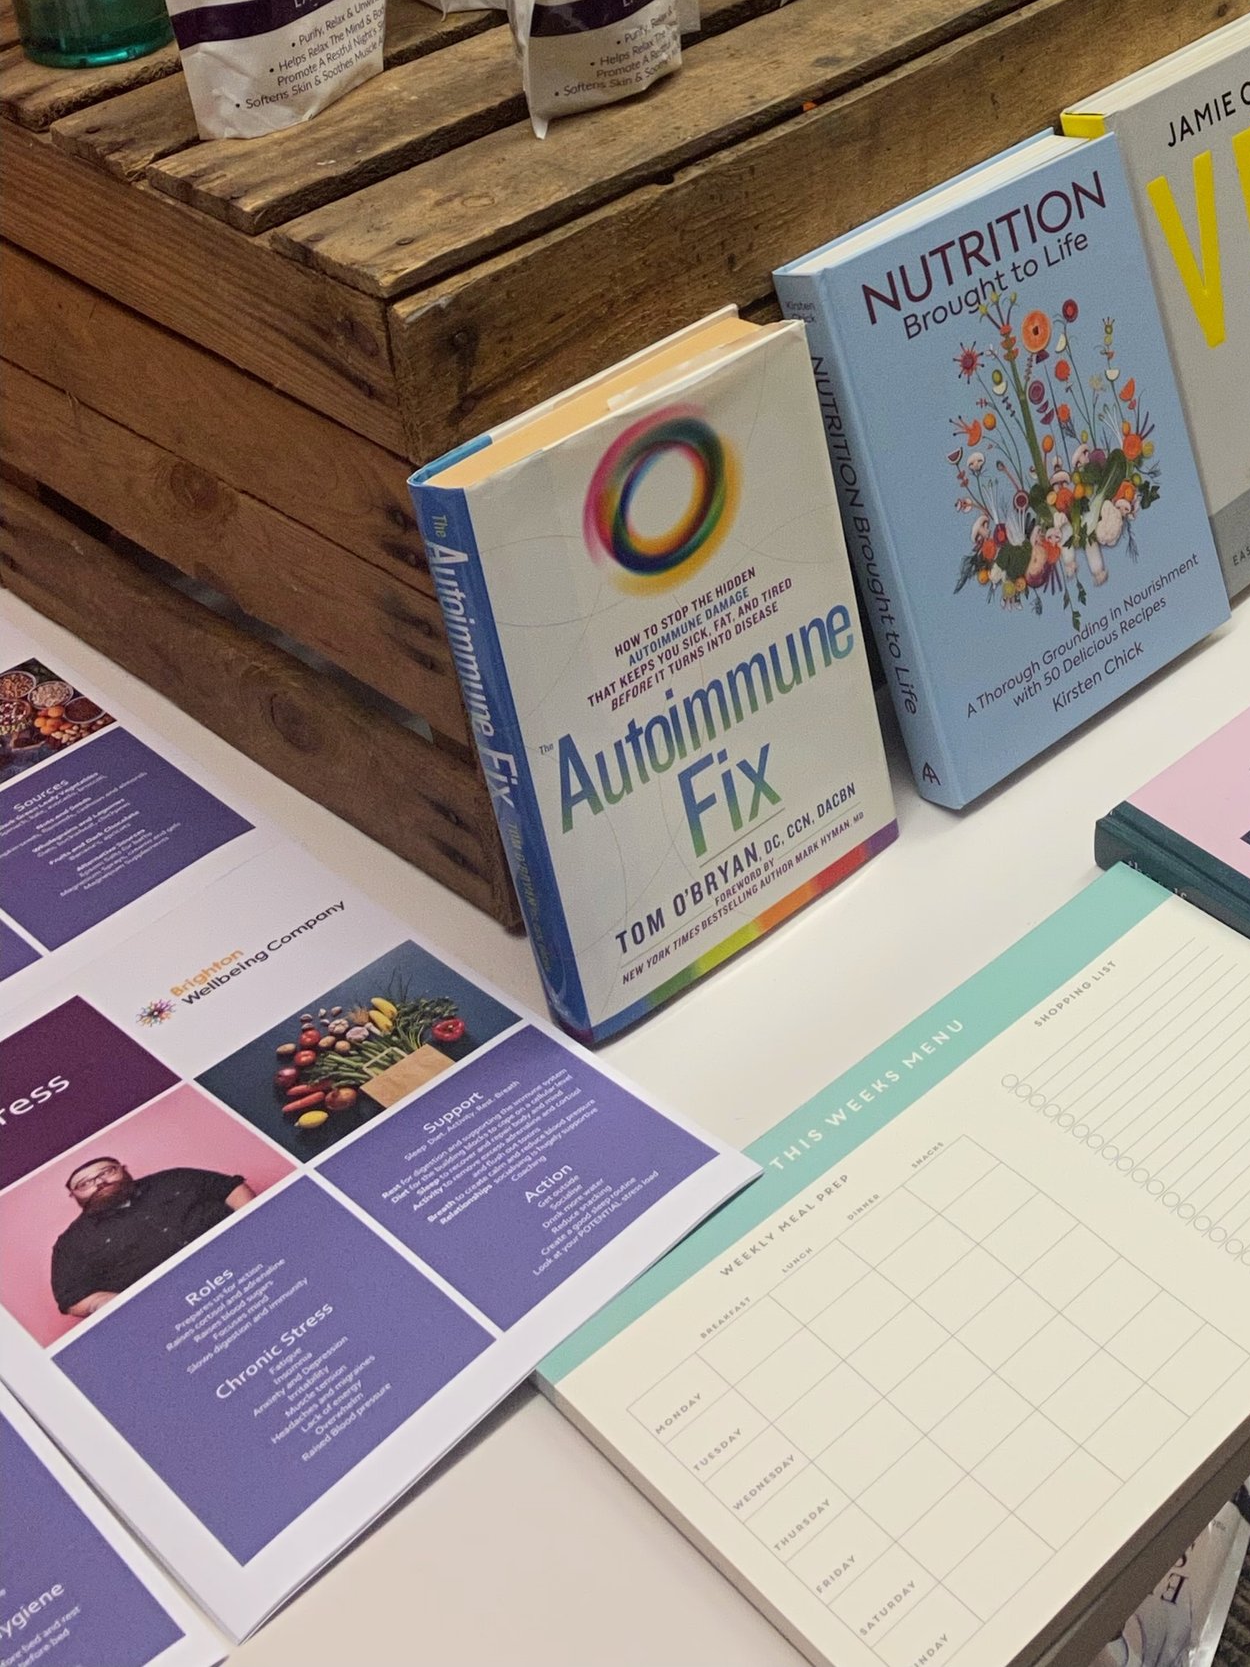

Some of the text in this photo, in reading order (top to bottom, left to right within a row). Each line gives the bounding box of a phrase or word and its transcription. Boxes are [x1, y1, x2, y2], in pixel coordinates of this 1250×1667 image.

[1166, 90, 1238, 149] JAMIE
[860, 169, 1107, 326] NUTRITION
[902, 230, 1090, 341] Brought to Life
[613, 565, 757, 659] HOW TO STOP THE HIDDEN
[627, 585, 751, 668] AUTOIMMUNE DAMAGE
[966, 551, 1201, 719] A Thorough Grounding in Nourishment
[1012, 594, 1168, 708] with 50 Delicious Recipes
[1052, 639, 1145, 713] Kirsten Chick
[557, 603, 856, 836] Autoimmune
[12, 777, 70, 814] Sources
[676, 741, 783, 860] Fix
[614, 906, 667, 956] TOM
[816, 781, 858, 820] DACBN
[168, 947, 246, 998] Brighton
[180, 899, 347, 1008] Wellbeing Company
[1033, 960, 1117, 1028] SHOPPING LIST
[0, 1074, 71, 1127] ress
[422, 1090, 485, 1136] Support
[768, 1018, 965, 1172] THIS WEEKS MENU
[524, 1163, 574, 1204] Action
[911, 1141, 945, 1170] SNACKS
[719, 1173, 850, 1277] WEEKLY MEAL PREP
[846, 1192, 881, 1222] DINNER
[184, 1268, 235, 1307] Roles
[781, 1245, 814, 1274] LUNCH
[699, 1295, 752, 1340] BREAKFAST
[215, 1302, 335, 1400] Chronic Stress
[654, 1392, 704, 1436] MONDAY
[693, 1427, 744, 1473] TUESDAY
[732, 1453, 797, 1512] WEDNESDAY
[773, 1497, 832, 1553] THURSDAY
[815, 1553, 857, 1595] FRIDAY
[0, 1583, 65, 1639] ygiene
[858, 1579, 917, 1637] SATURDAY
